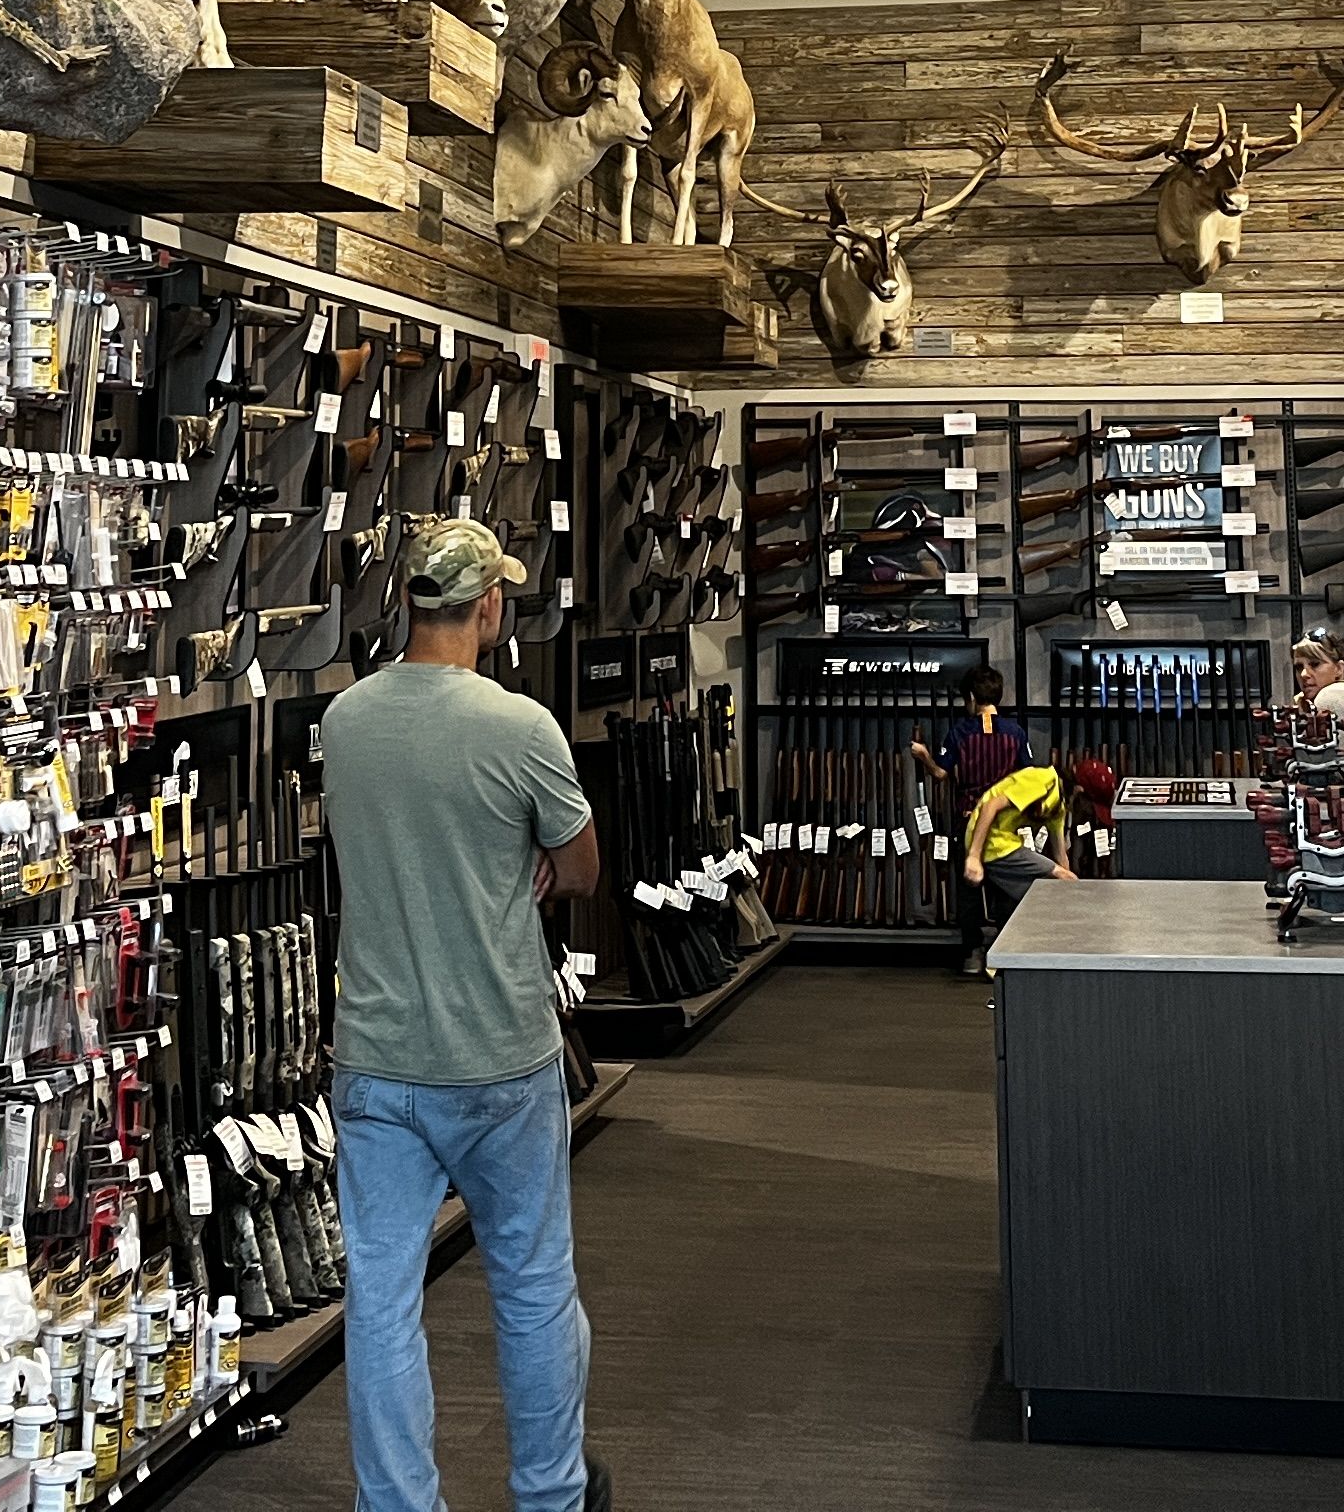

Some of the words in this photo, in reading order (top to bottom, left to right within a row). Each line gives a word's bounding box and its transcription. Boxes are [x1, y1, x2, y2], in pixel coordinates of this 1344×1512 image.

[1115, 444, 1154, 474] WE
[1159, 444, 1203, 474] BUY
[1116, 482, 1206, 520] GUNS
